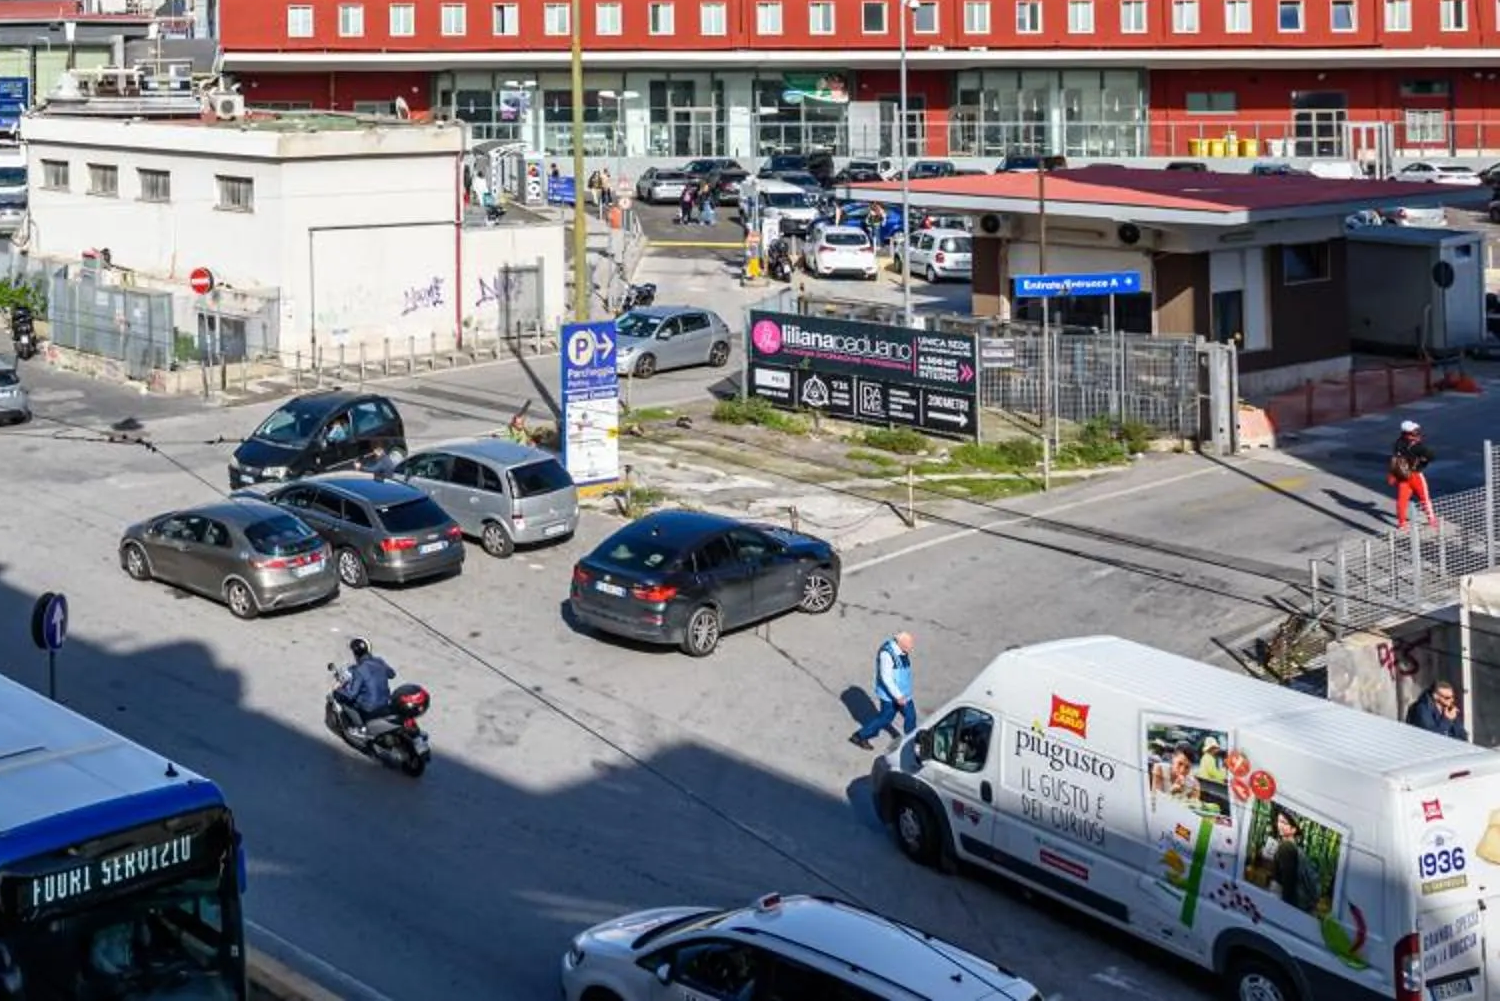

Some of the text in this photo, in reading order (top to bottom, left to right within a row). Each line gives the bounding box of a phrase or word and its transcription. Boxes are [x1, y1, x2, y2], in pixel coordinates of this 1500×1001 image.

[575, 338, 588, 360] P
[1053, 712, 1085, 730] CARLO
[1021, 766, 1035, 792] IL
[1040, 774, 1089, 814] GUSTO
[1021, 794, 1106, 846] DEI CURIOSI
[33, 834, 192, 907] FUORI SERVIZIO
[1418, 847, 1465, 878] 1936
